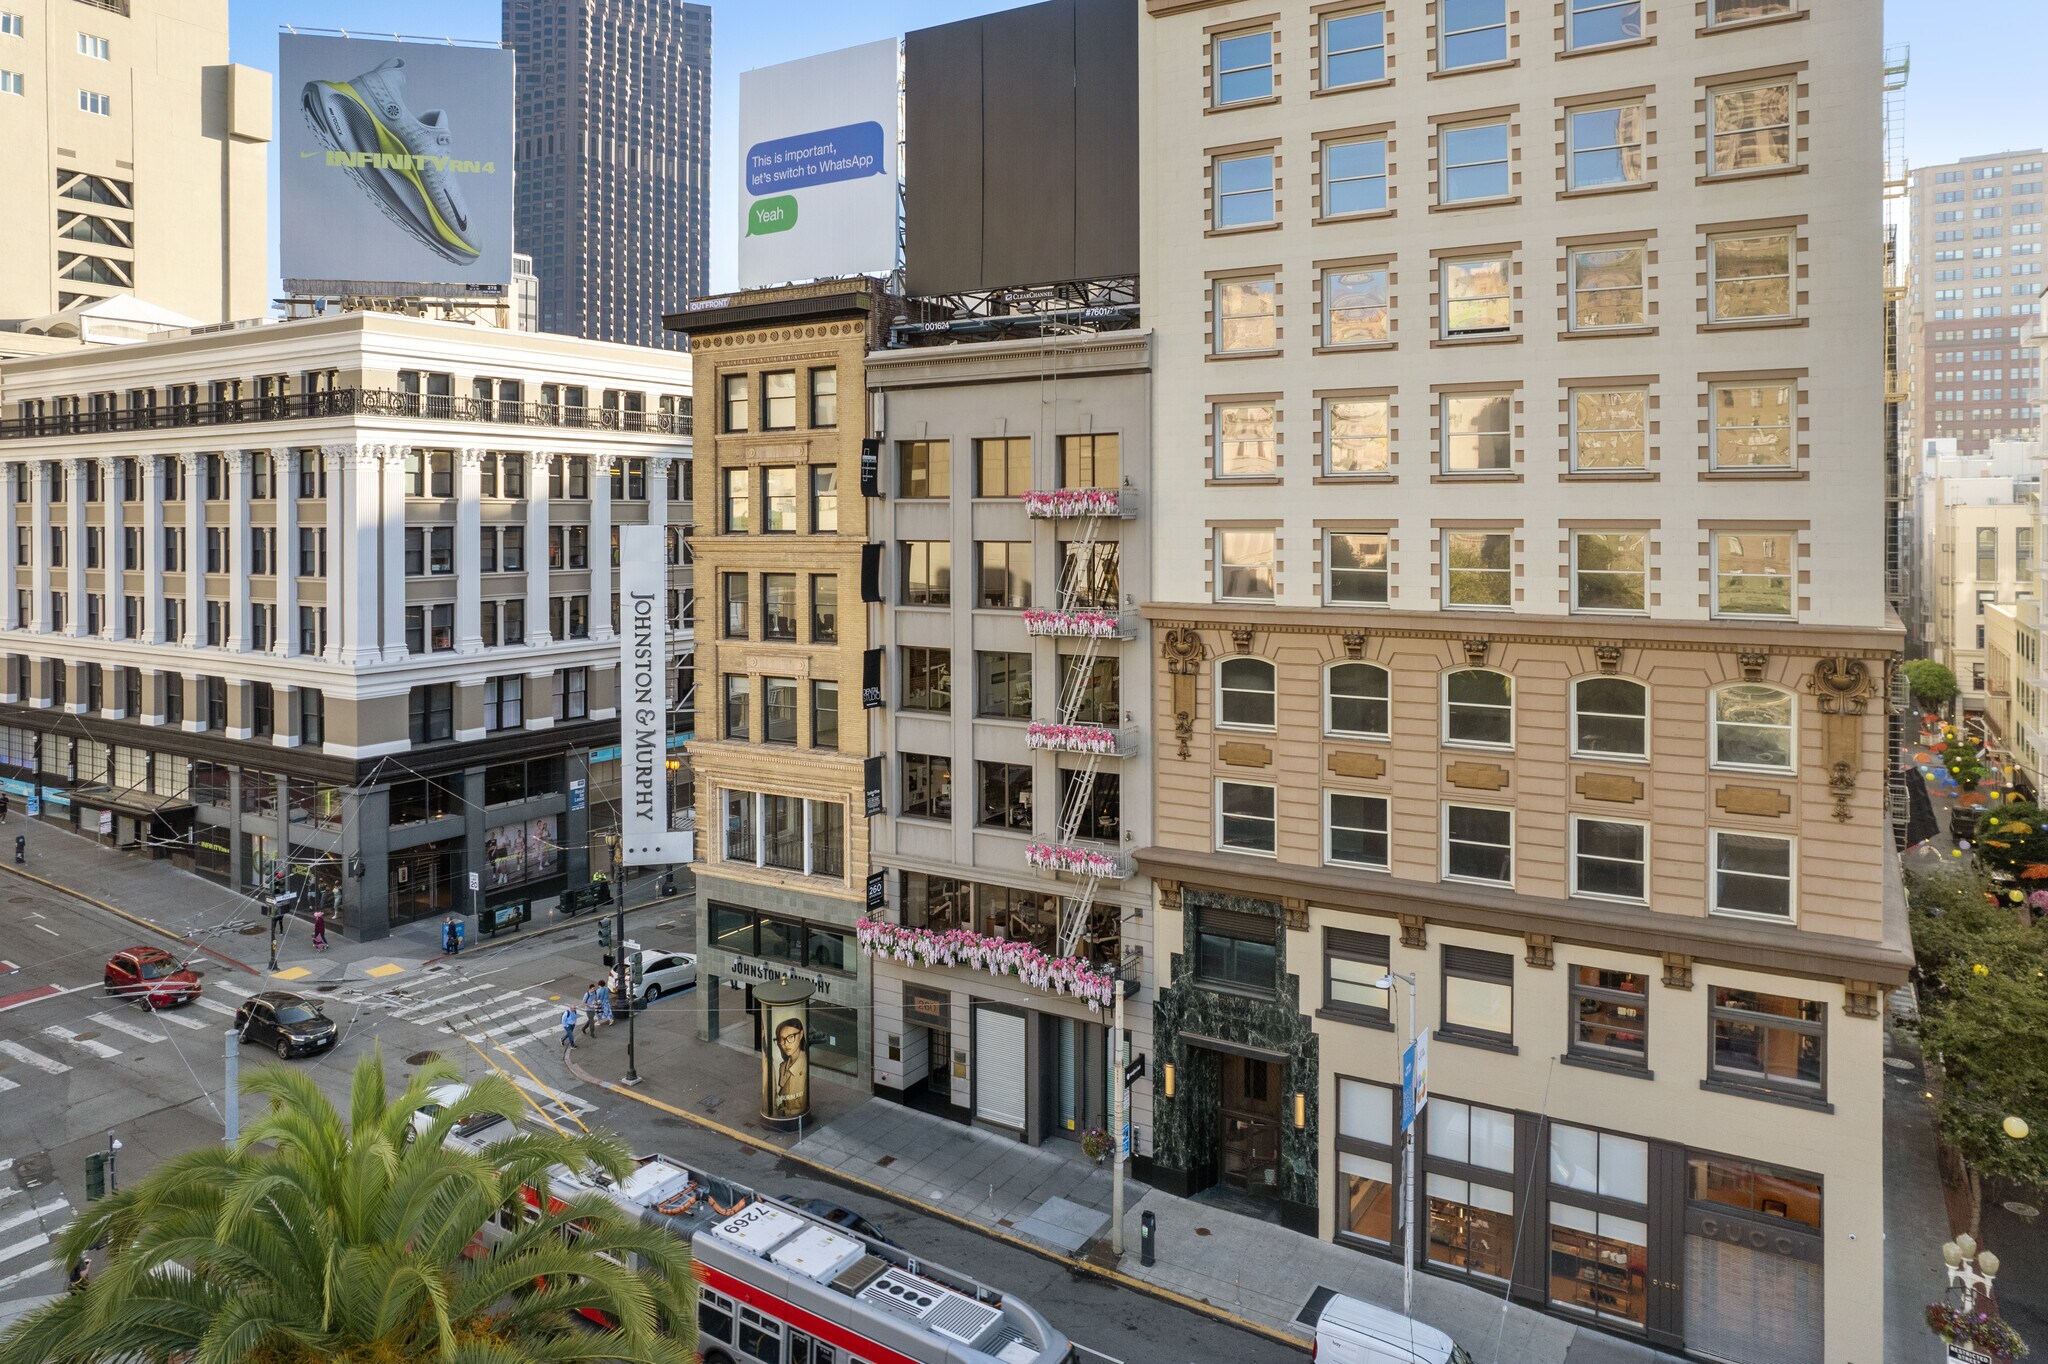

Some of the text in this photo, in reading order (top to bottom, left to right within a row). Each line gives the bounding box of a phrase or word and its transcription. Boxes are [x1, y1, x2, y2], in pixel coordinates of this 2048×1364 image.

[326, 151, 449, 172] INFINITY
[752, 142, 837, 168] This is important,
[751, 155, 873, 186] let's switch to WhatsApp
[756, 206, 784, 223] Yeah
[925, 321, 949, 331] 001624
[631, 590, 656, 822] JOHNSTON & MURPHY
[869, 883, 882, 895] 260
[731, 962, 780, 981] JOHNSTON
[918, 1000, 937, 1013] 260
[724, 1207, 770, 1234] 7269
[1701, 1219, 1806, 1256] GUCCI
[1950, 1345, 1989, 1363] RESTRICTED
